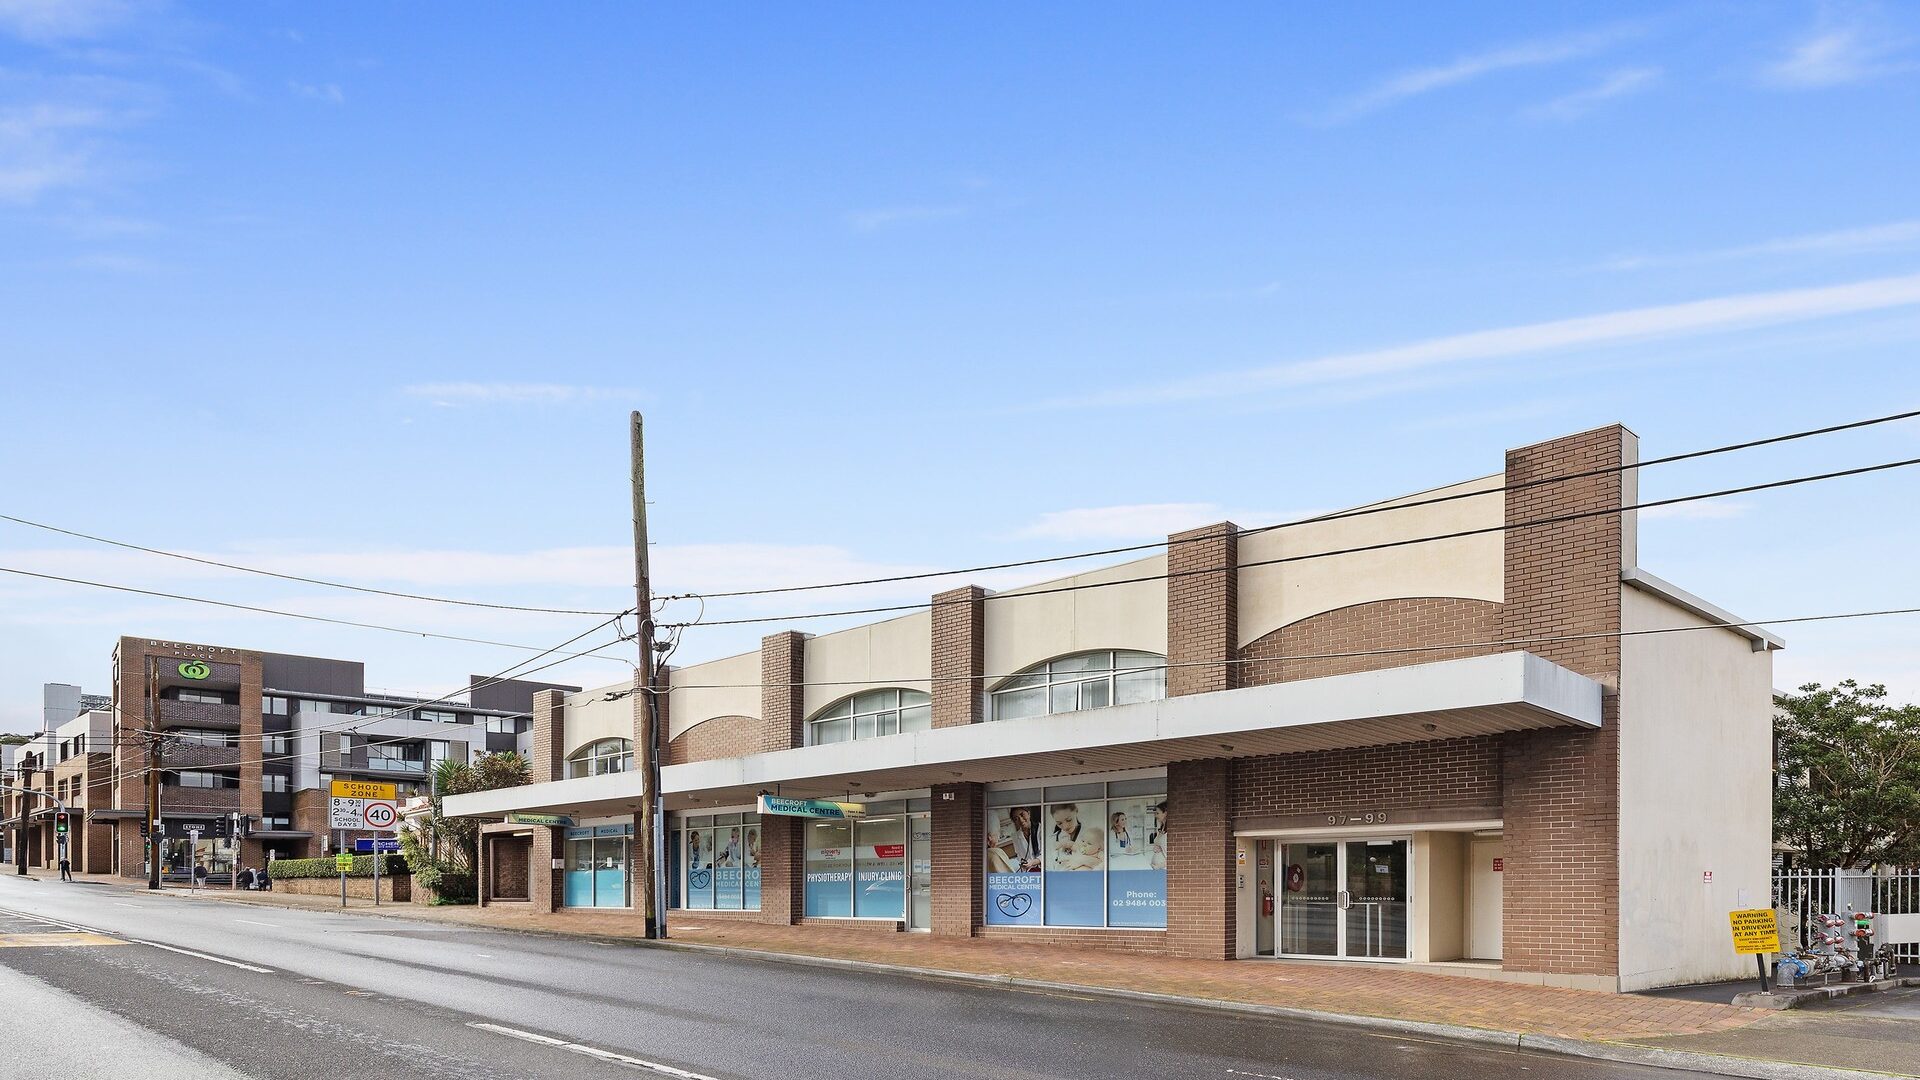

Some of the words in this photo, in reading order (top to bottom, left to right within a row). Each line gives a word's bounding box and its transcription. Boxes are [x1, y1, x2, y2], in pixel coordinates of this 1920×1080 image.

[150, 641, 237, 655] BEECROFT
[174, 651, 214, 660] PLACE
[343, 783, 384, 792] SCHOOL
[771, 798, 807, 806] BEECROFT
[770, 804, 808, 814] MEDICAL
[809, 807, 840, 816] CENTRE
[370, 810, 391, 821] 40
[806, 872, 852, 882] PHYSIOTHERAPY
[858, 872, 879, 881] INJURY
[880, 871, 902, 881] CLINIC
[990, 876, 1041, 884] BEECROFT
